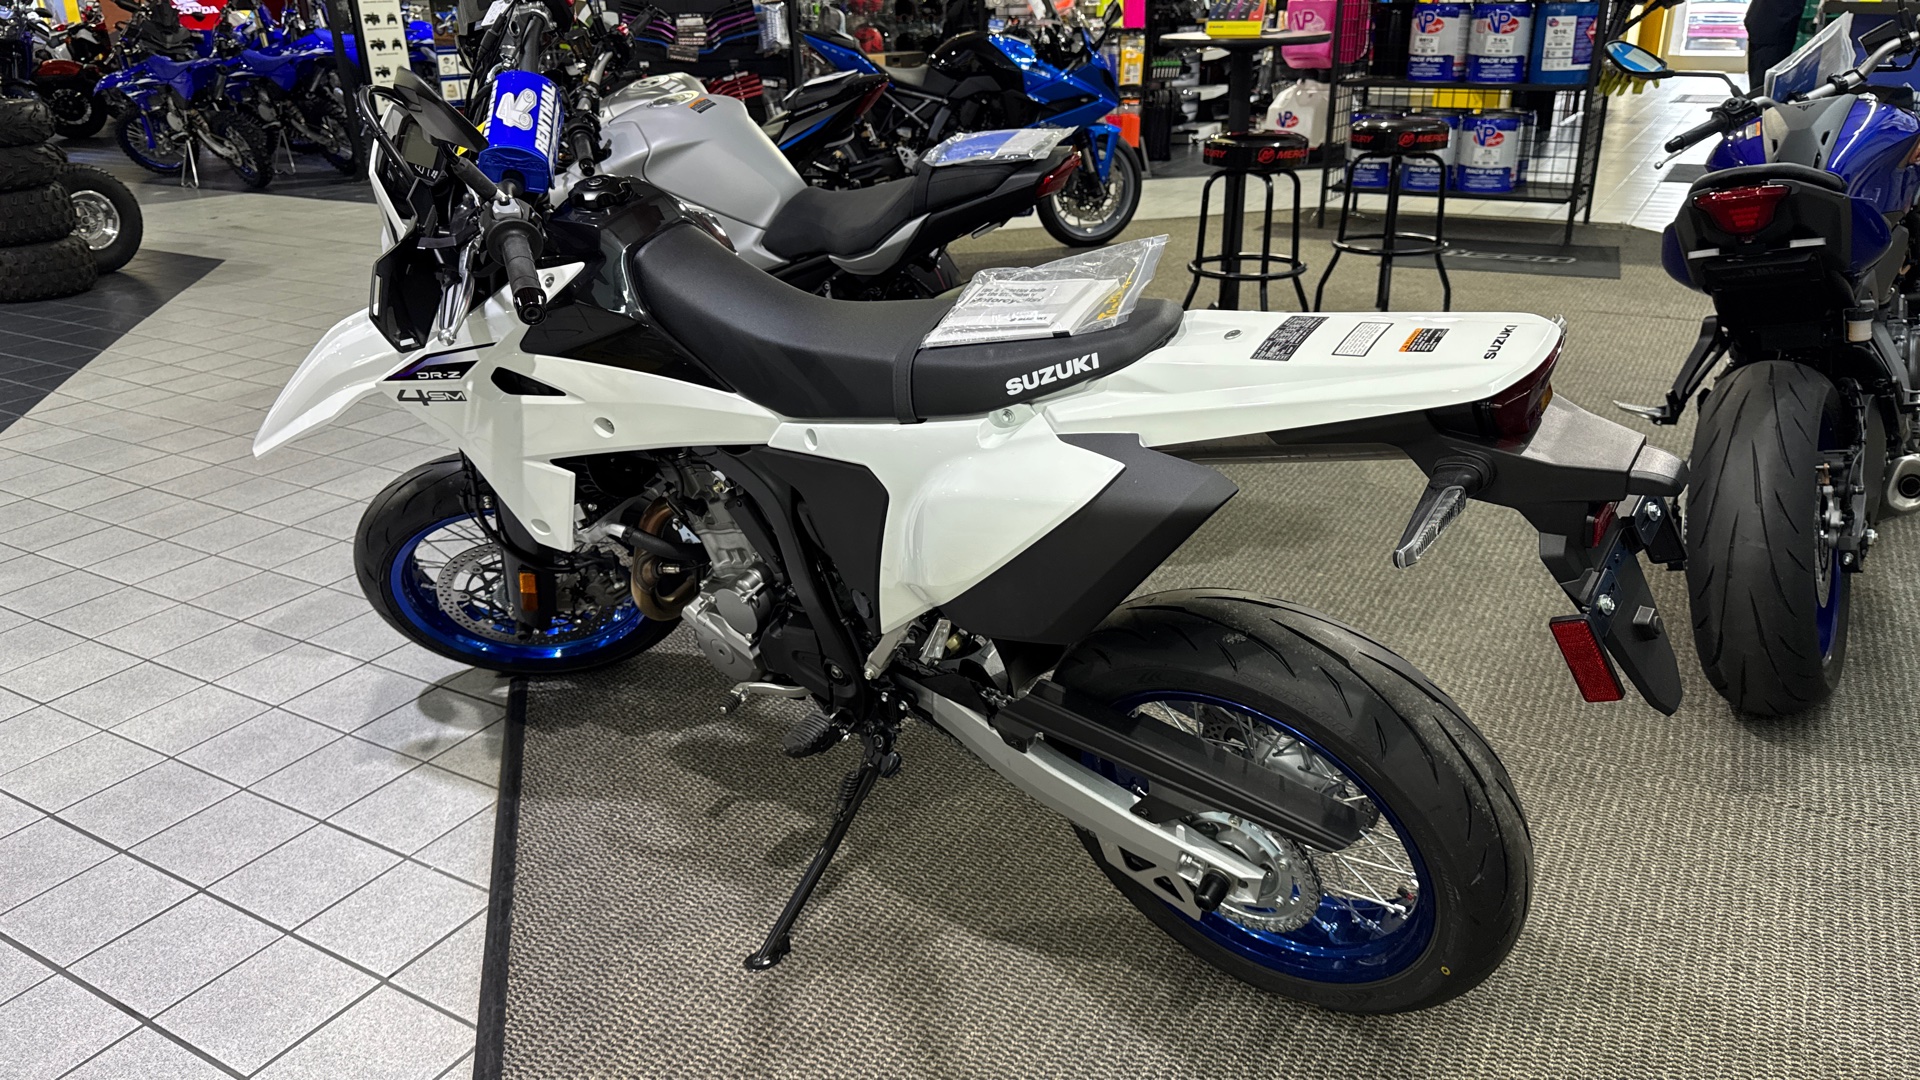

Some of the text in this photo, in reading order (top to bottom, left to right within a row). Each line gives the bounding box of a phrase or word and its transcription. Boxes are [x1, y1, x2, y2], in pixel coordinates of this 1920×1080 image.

[171, 5, 220, 15] ONDA
[1417, 11, 1436, 34] VP
[1488, 10, 1512, 34] VP
[534, 83, 556, 158] RENTHAL
[1278, 111, 1293, 128] VP
[1474, 125, 1497, 147] VP
[1483, 324, 1519, 360] SUZUKI
[416, 371, 461, 380] DR-Z
[1005, 352, 1100, 396] SUZUKI
